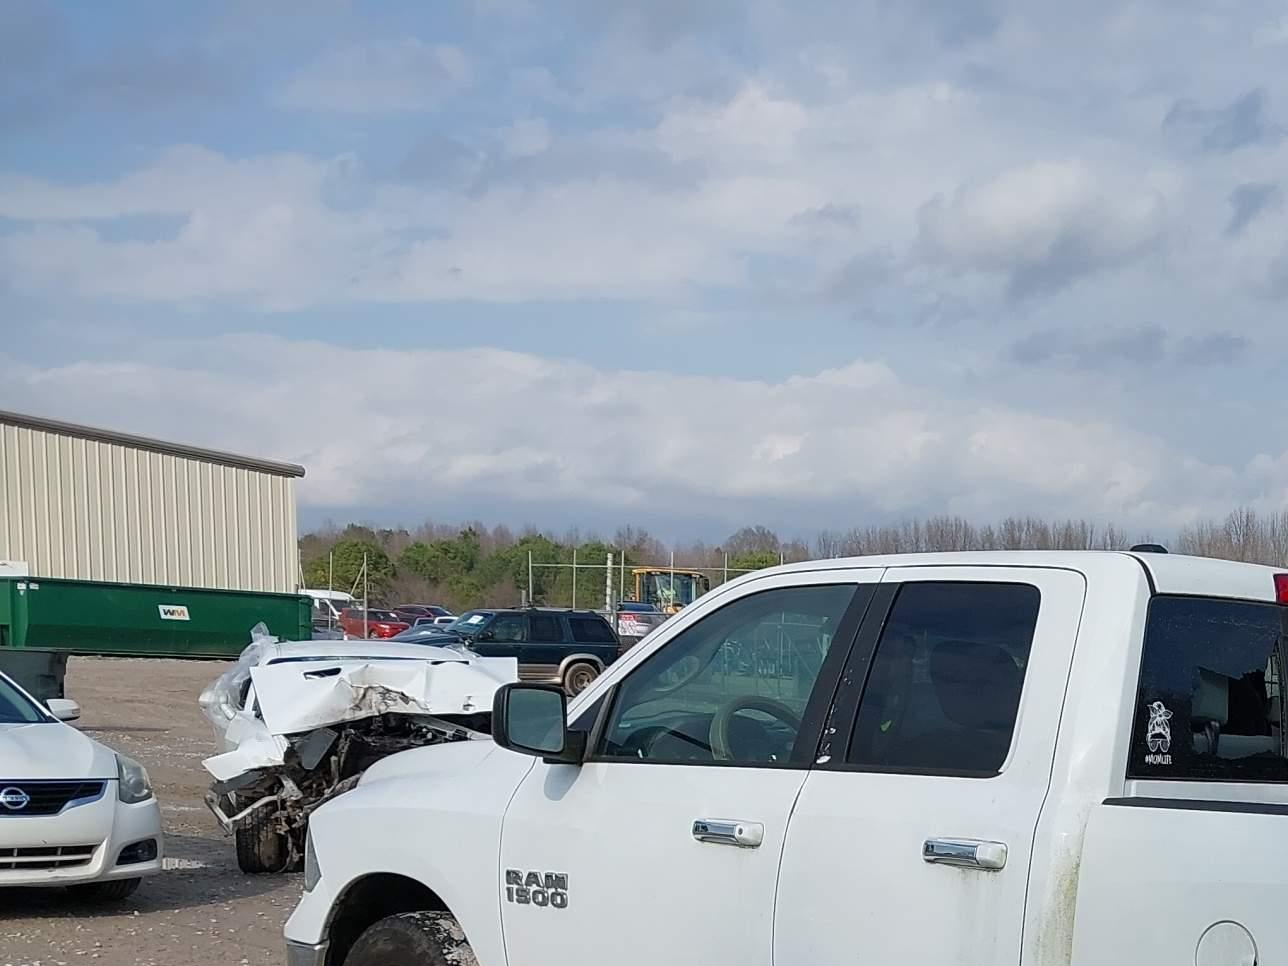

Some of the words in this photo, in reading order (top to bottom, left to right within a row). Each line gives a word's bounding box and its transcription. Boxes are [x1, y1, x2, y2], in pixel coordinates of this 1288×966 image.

[162, 608, 186, 617] WM
[506, 869, 568, 891] RAM
[506, 887, 568, 908] 1500
